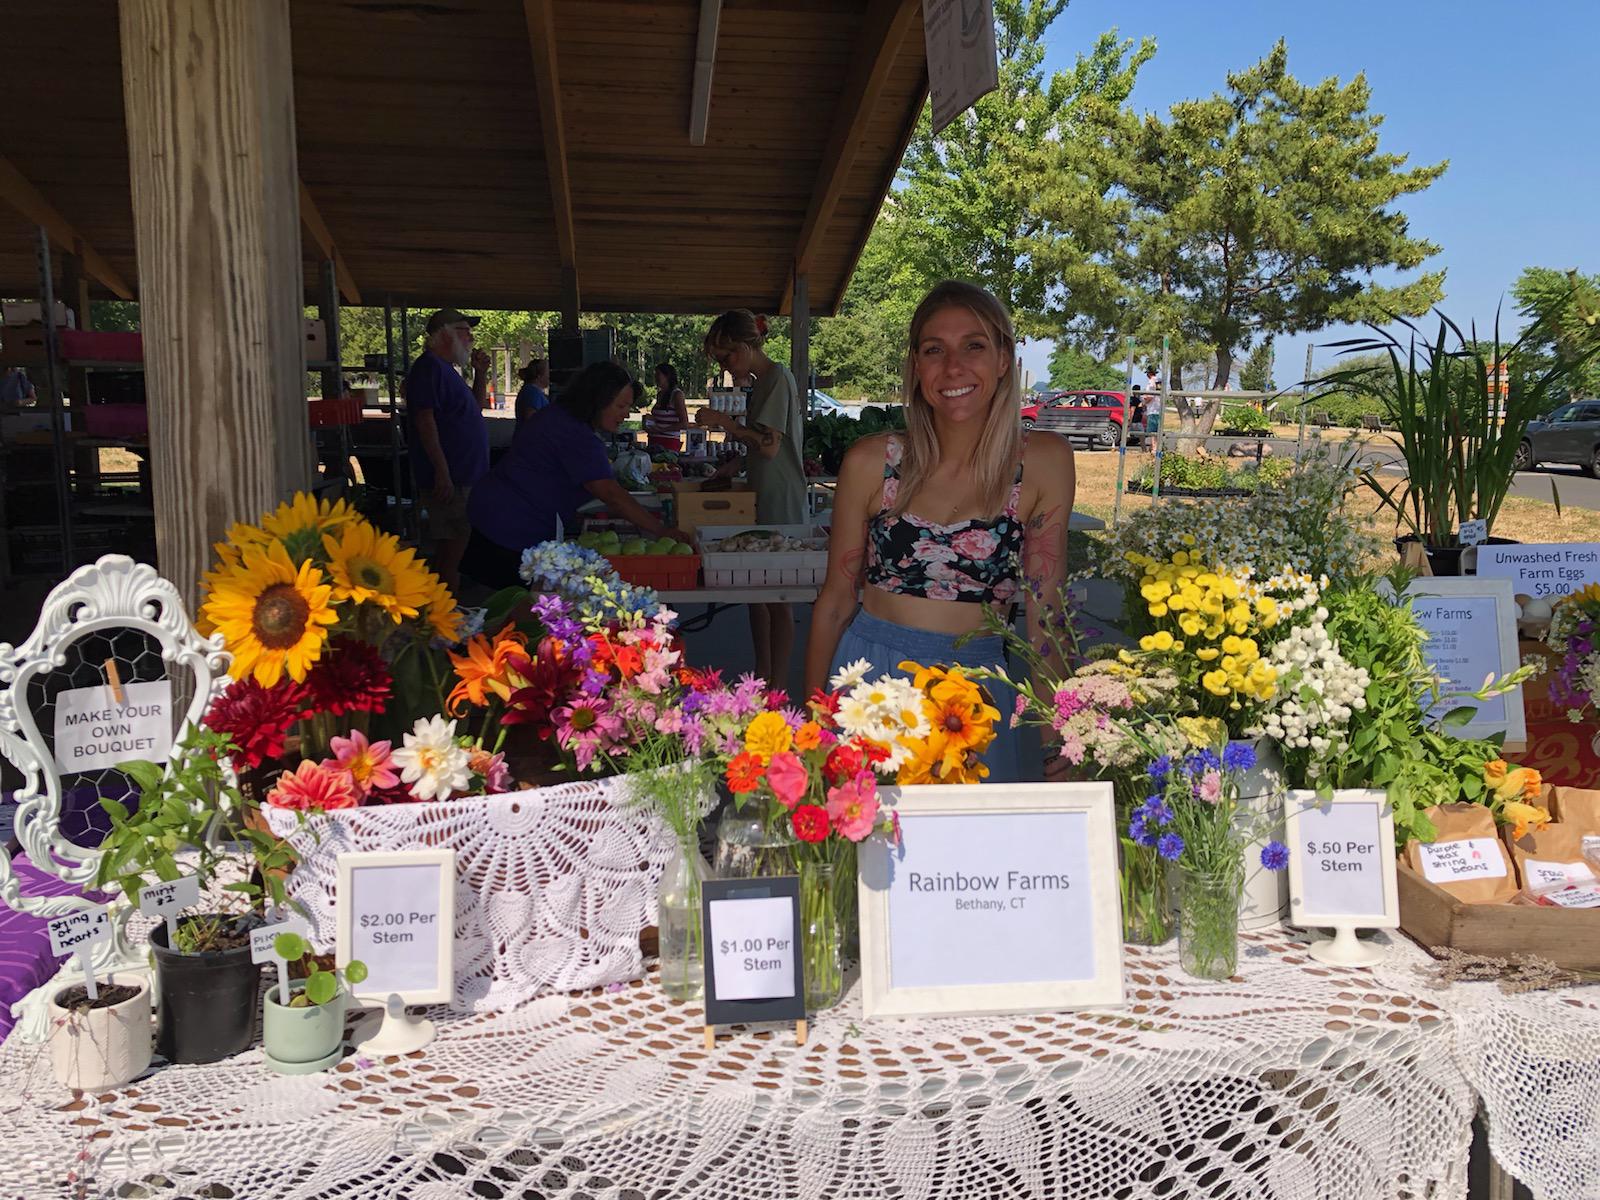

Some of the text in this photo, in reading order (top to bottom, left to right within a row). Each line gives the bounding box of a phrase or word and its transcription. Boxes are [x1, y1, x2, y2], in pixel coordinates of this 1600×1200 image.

[1495, 551, 1598, 564] Unwashed Fresh
[1520, 567, 1585, 581] Farm Eggs
[1535, 583, 1570, 595] $5.00
[1436, 608, 1473, 620] Farms
[65, 704, 162, 727] MAKE YOUR
[92, 723, 132, 739] OWN
[73, 737, 156, 758] BOUQUET
[1307, 841, 1375, 856] $.50 Per
[1321, 859, 1363, 872] Stem
[1451, 862, 1489, 874] beans
[909, 870, 1070, 892] Rainbow Farms
[955, 897, 1026, 912] Bethany, CT
[360, 911, 437, 928] $2.00 Per
[372, 931, 414, 944] Stem
[720, 937, 791, 955] $1.00 Per
[743, 958, 782, 972] Stem
